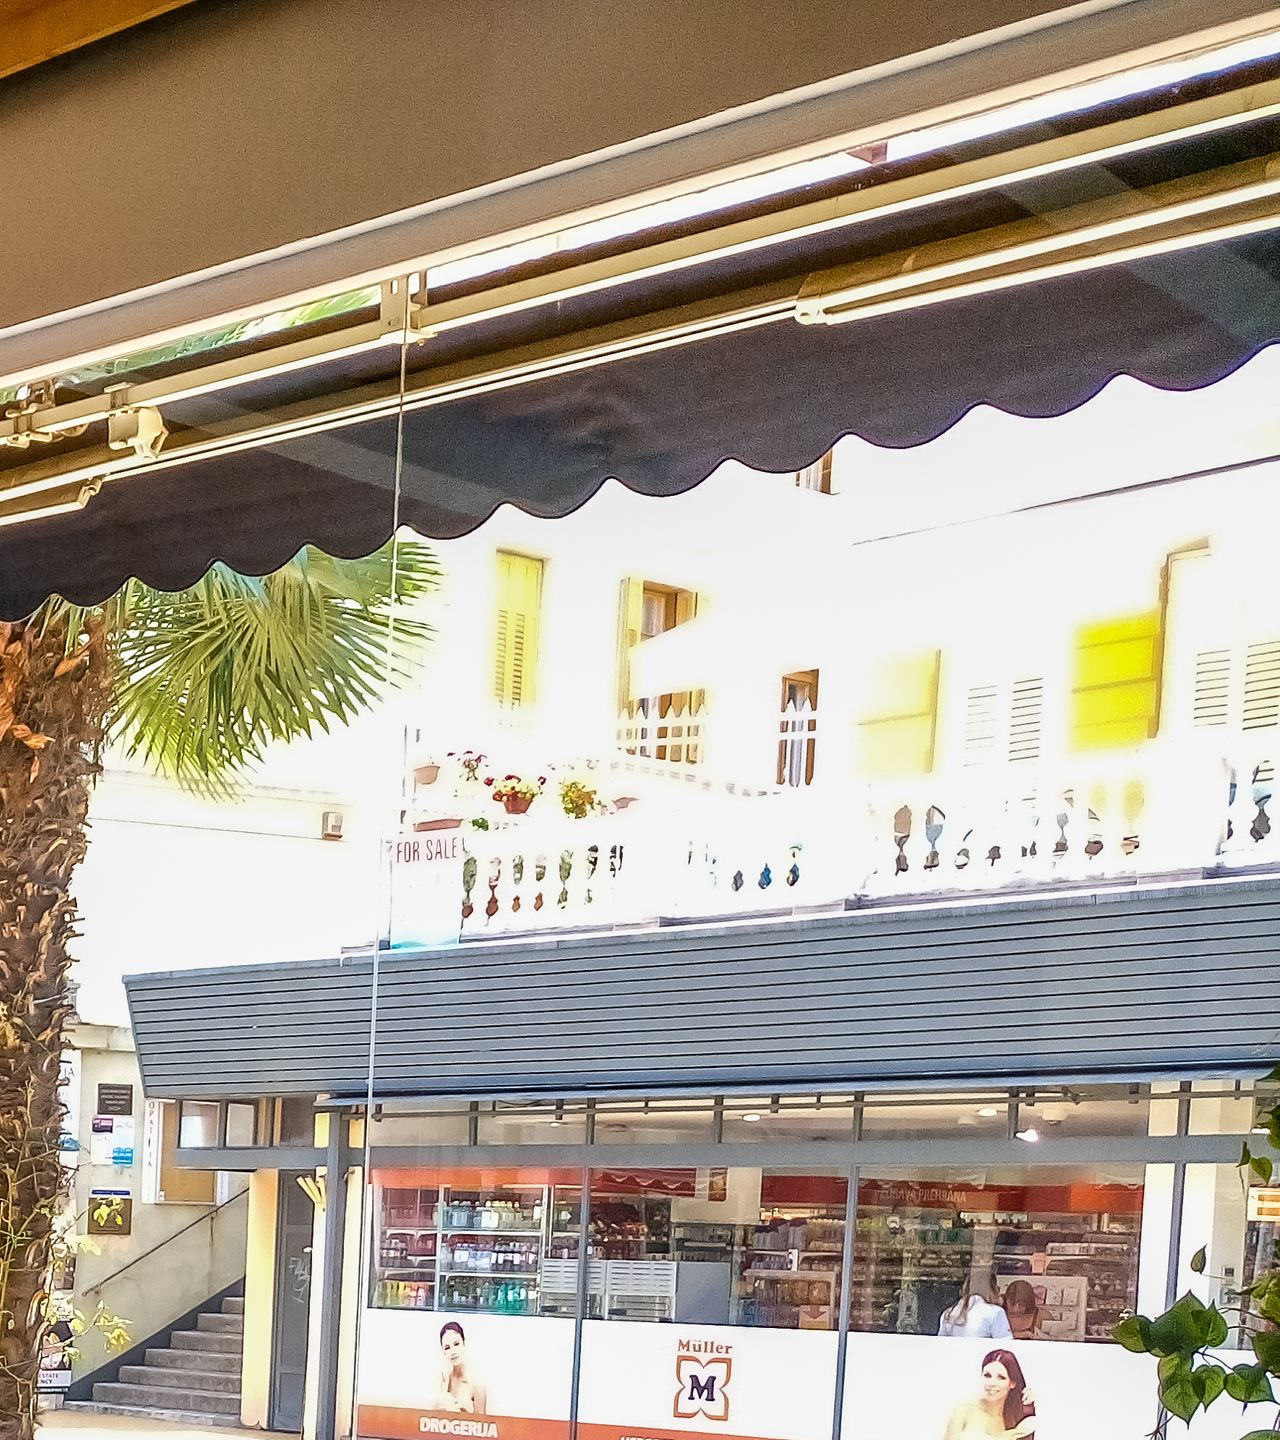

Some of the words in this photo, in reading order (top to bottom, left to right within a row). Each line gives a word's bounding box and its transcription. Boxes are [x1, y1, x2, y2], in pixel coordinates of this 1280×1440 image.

[396, 841, 420, 863] FOR
[426, 837, 457, 860] SALE
[678, 1338, 733, 1355] Müller
[687, 1374, 717, 1402] M
[419, 1416, 499, 1439] DROGERIJA
